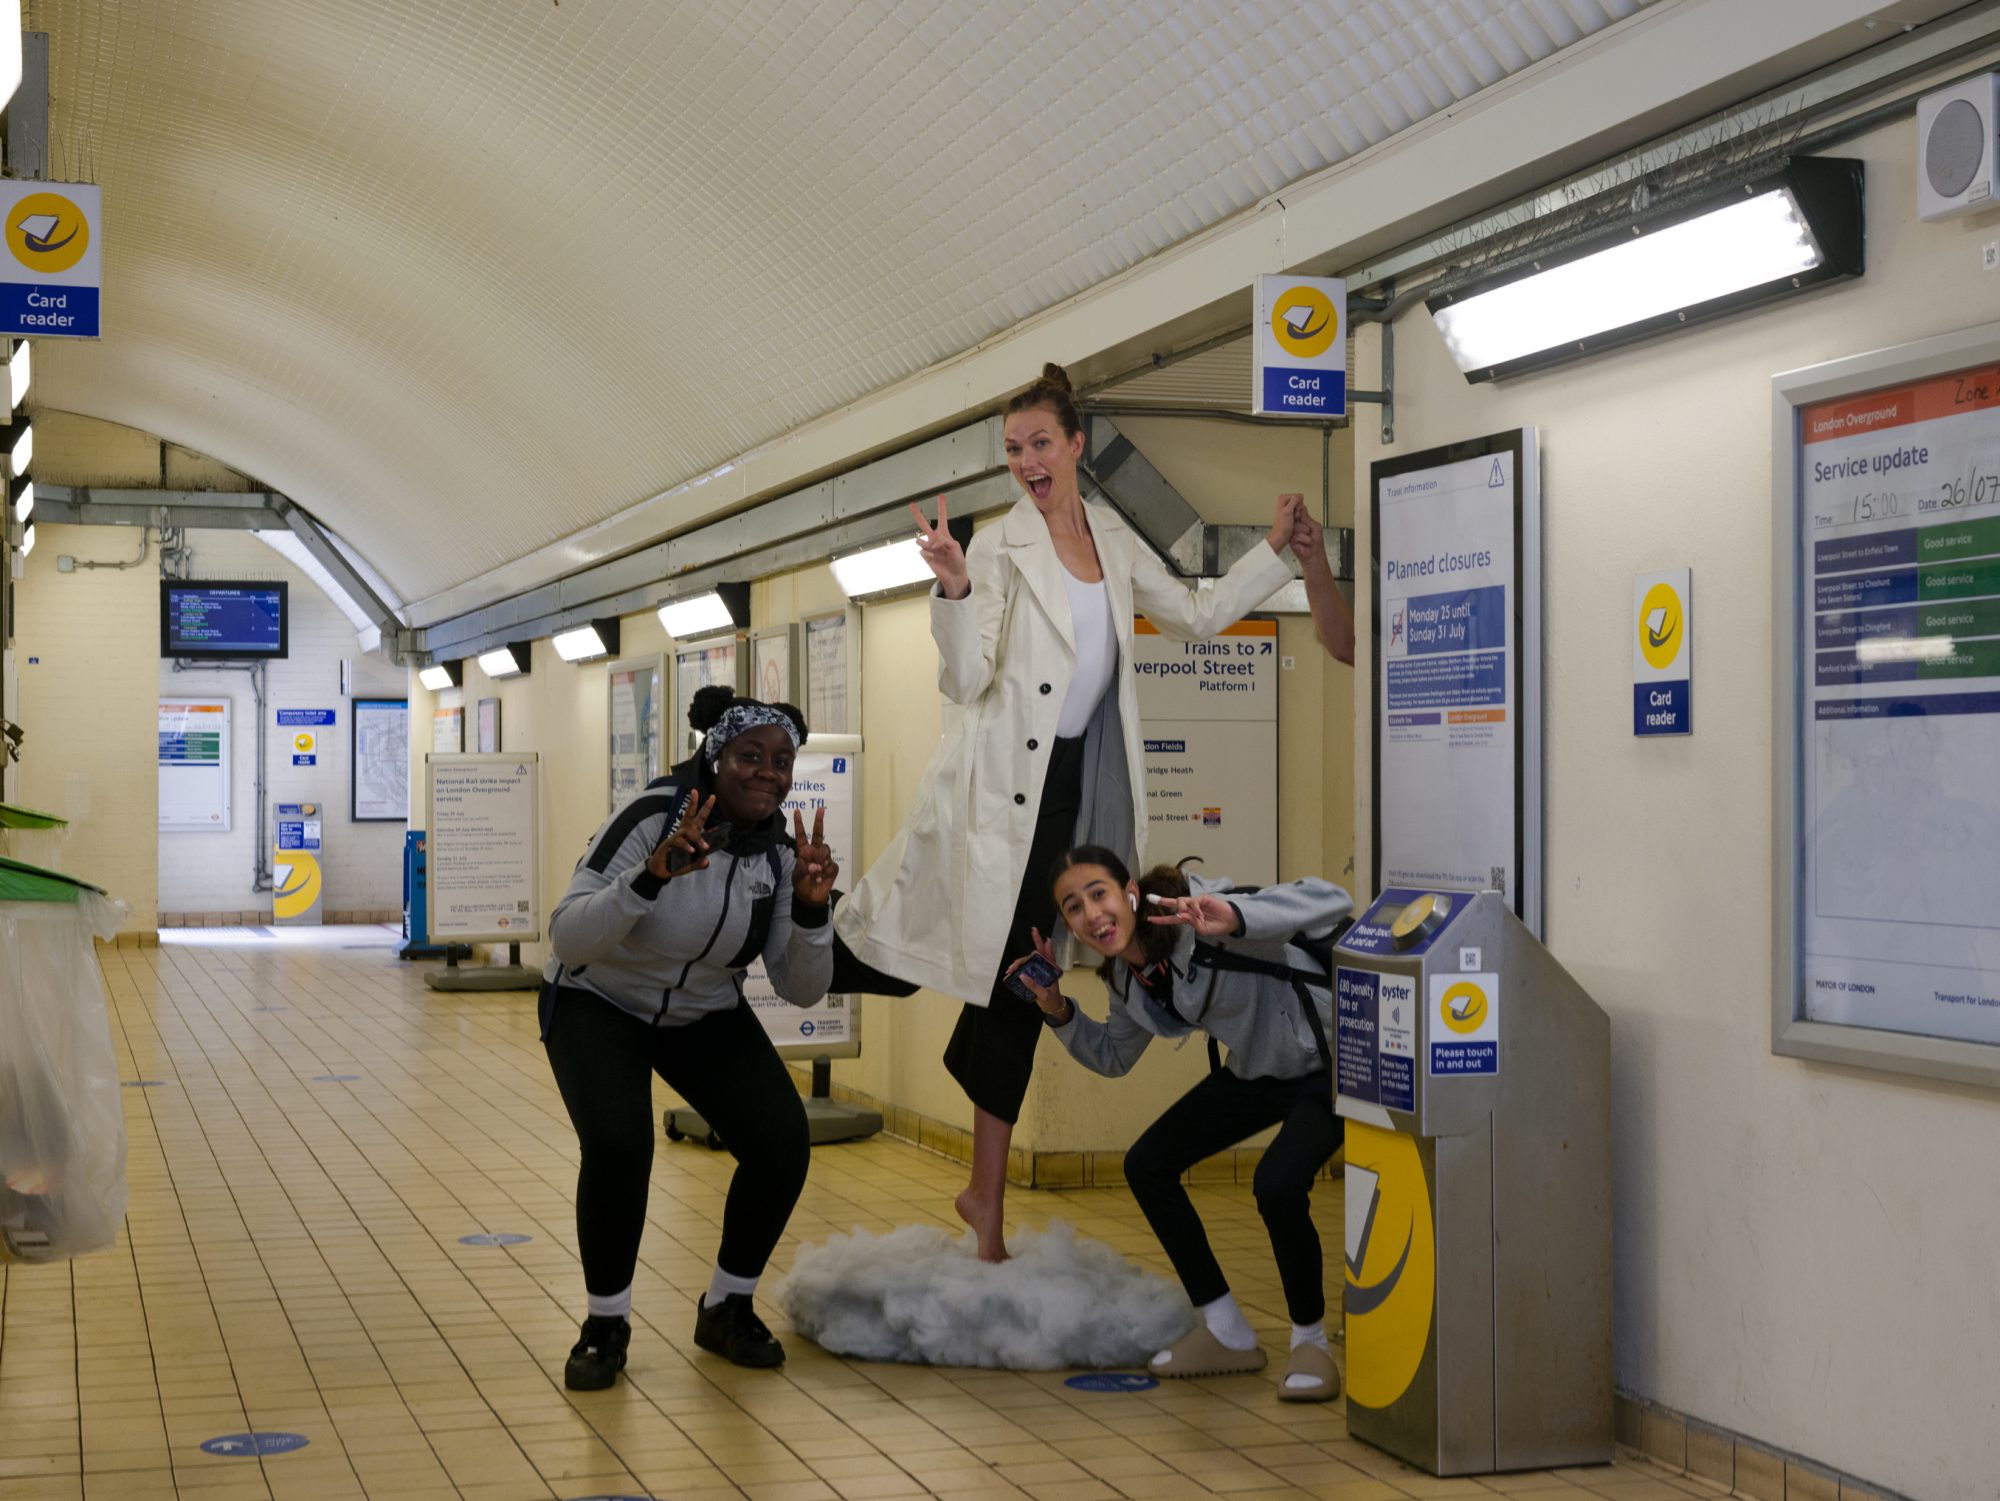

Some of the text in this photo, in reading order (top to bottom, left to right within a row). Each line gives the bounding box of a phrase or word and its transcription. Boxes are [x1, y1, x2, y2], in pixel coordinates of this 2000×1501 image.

[26, 292, 67, 308] Card
[20, 313, 75, 327] reader
[1288, 376, 1320, 390] Card
[1954, 379, 1989, 405] Zone
[1282, 393, 1326, 406] reader
[1813, 404, 1898, 433] London Overground
[1814, 446, 1929, 482] Service update
[1403, 481, 1438, 494] information
[1853, 491, 1898, 522] 15:00
[1923, 534, 1973, 549] Good service
[1817, 544, 1899, 562] Liverpool Street to Enfield Town
[1387, 551, 1491, 581] Planned closures
[1817, 578, 1891, 594] Liverpool Street to Cheshunt
[1925, 573, 1974, 588] Good service
[1828, 595, 1843, 604] Seven
[1409, 602, 1471, 625] Monday 25 until
[1925, 613, 1975, 628] Good service
[1409, 623, 1466, 643] Sunday 31 July
[1817, 628, 1841, 638] Liverpool
[1841, 626, 1857, 635] Street
[1865, 623, 1892, 635] Chingford
[1237, 641, 1255, 655] to
[1925, 653, 1974, 667] Good service
[1134, 660, 1256, 678] verpool Street
[1817, 664, 1840, 674] Romford
[1199, 680, 1248, 692] Platform
[1649, 690, 1672, 706] Card
[1818, 704, 1846, 716] Additional
[1464, 712, 1489, 724] Overground
[1646, 710, 1677, 726] reader
[1161, 742, 1183, 751] Fields
[1170, 766, 1194, 775] Heath
[499, 778, 521, 786] impact
[472, 786, 511, 795] Overground
[1159, 791, 1183, 799] Green
[436, 795, 463, 803] services
[780, 799, 806, 809] ome
[1165, 814, 1188, 822] Street
[1375, 927, 1392, 938] touc
[1352, 937, 1366, 947] and
[1364, 938, 1379, 948] out
[1338, 979, 1375, 1001] £80 penalty
[1381, 985, 1409, 1002] oyster
[1815, 979, 1876, 995] MAYOR OF LONDON
[1338, 997, 1359, 1013] fare or
[1934, 991, 1966, 1005] Transport
[1967, 996, 1977, 1006] for
[1338, 1014, 1375, 1034] prosecution
[1436, 1046, 1493, 1059] Please touch
[1395, 1060, 1408, 1071] touch
[1436, 1058, 1482, 1070] in and out
[1388, 1079, 1396, 1088] the
[1395, 1080, 1411, 1093] reader
